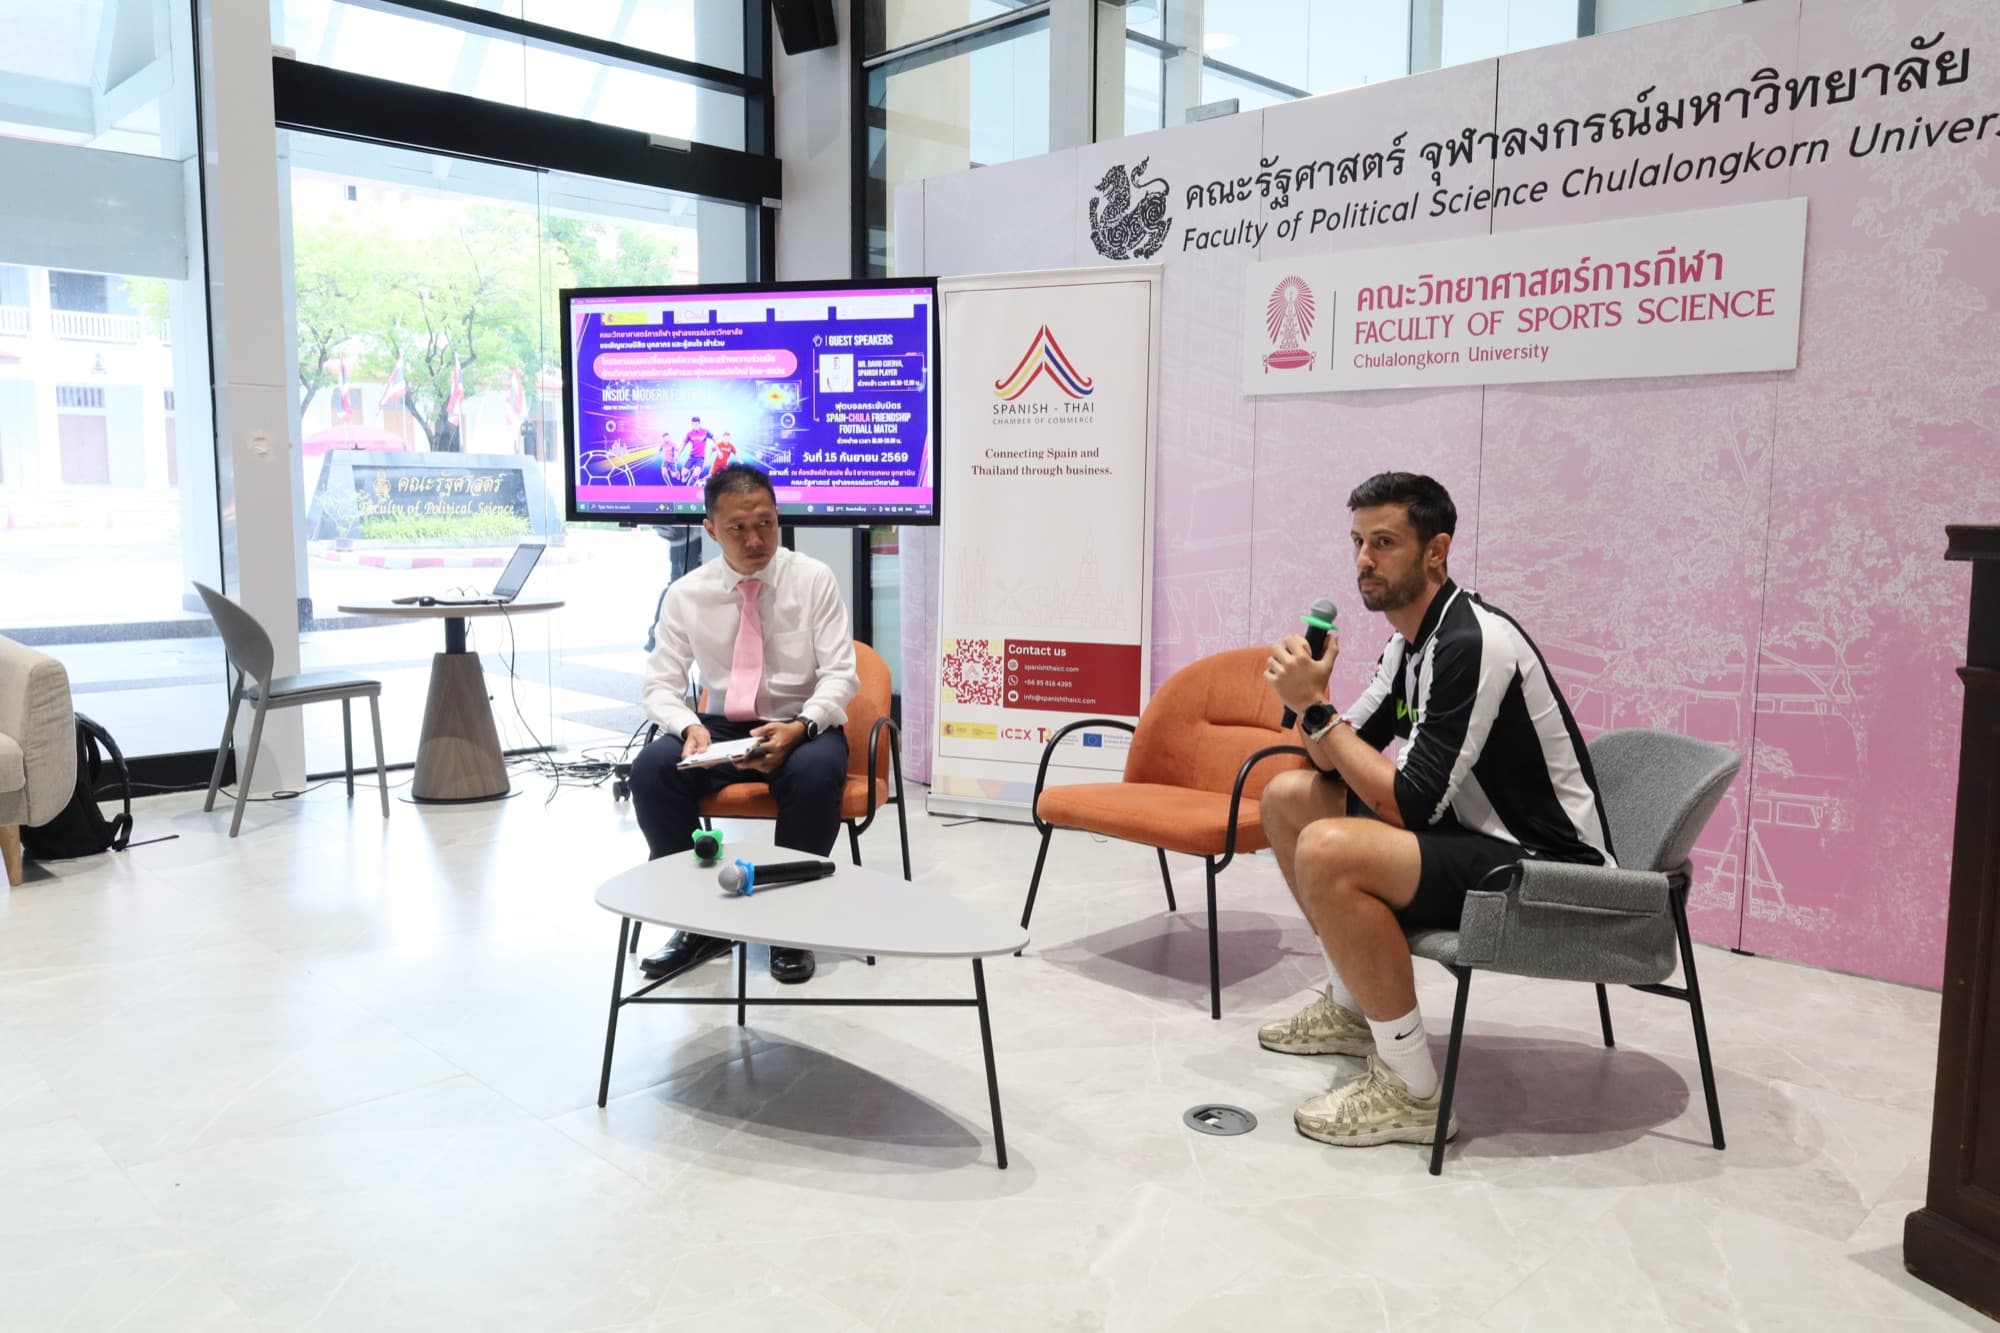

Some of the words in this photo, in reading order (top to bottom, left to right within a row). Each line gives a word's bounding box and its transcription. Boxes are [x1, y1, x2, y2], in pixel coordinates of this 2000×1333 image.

[1186, 131, 1408, 211] คณะรัฐศาสตร์
[1419, 31, 1970, 188] จุฬาลงกรณ์มหาวิทยาลัย
[1183, 219, 1269, 252] Faculty
[1277, 210, 1304, 241] of
[1310, 191, 1419, 234] Political
[1429, 180, 1548, 217] Science
[1562, 138, 1829, 198] Chulalongkorn
[1849, 112, 2000, 158] Univer
[1357, 246, 1723, 312] คณะวิทยาศาสตร์การกีฬา
[1355, 315, 1454, 344] FACULTY
[1467, 310, 1502, 336] OF
[1517, 301, 1623, 333] SPORTS
[1637, 288, 1776, 325] SCIENCE
[828, 335, 853, 346] GUEST
[854, 333, 894, 346] SPEAKERS
[1353, 348, 1460, 371] Chulalongkorn
[1468, 343, 1550, 364] University
[601, 387, 631, 401] INSIDE
[992, 402, 1049, 415] SPANISH
[1064, 402, 1094, 414] THAI
[826, 412, 871, 423] SPAIN-CHULA
[871, 412, 912, 422] FRIENDSHIP
[992, 417, 1032, 425] CHAMBER
[1034, 417, 1045, 425] OF
[1047, 416, 1094, 425] COMMERCE
[839, 424, 873, 434] FOOTBALL
[873, 423, 898, 434] MATCH
[802, 448, 823, 462] วันที่
[824, 452, 837, 462] 15
[839, 451, 879, 462] กันยายน
[881, 452, 909, 462] 2569
[985, 448, 1045, 460] Connecting
[1047, 448, 1078, 460] Spain
[1080, 448, 1099, 459] and
[972, 465, 1019, 476] Thailand
[1022, 465, 1064, 477] through
[1066, 464, 1113, 476] business.
[397, 470, 507, 500] คณะรัฐศาสตร์
[358, 501, 404, 515] Faculty
[407, 501, 421, 515] of
[424, 501, 472, 515] Political
[478, 501, 514, 515] Science
[1008, 644, 1052, 657] Contact
[1054, 647, 1067, 657] us
[1024, 664, 1080, 673] spanishthaicc.com
[1023, 694, 1096, 704] info@spanishthaicc.com
